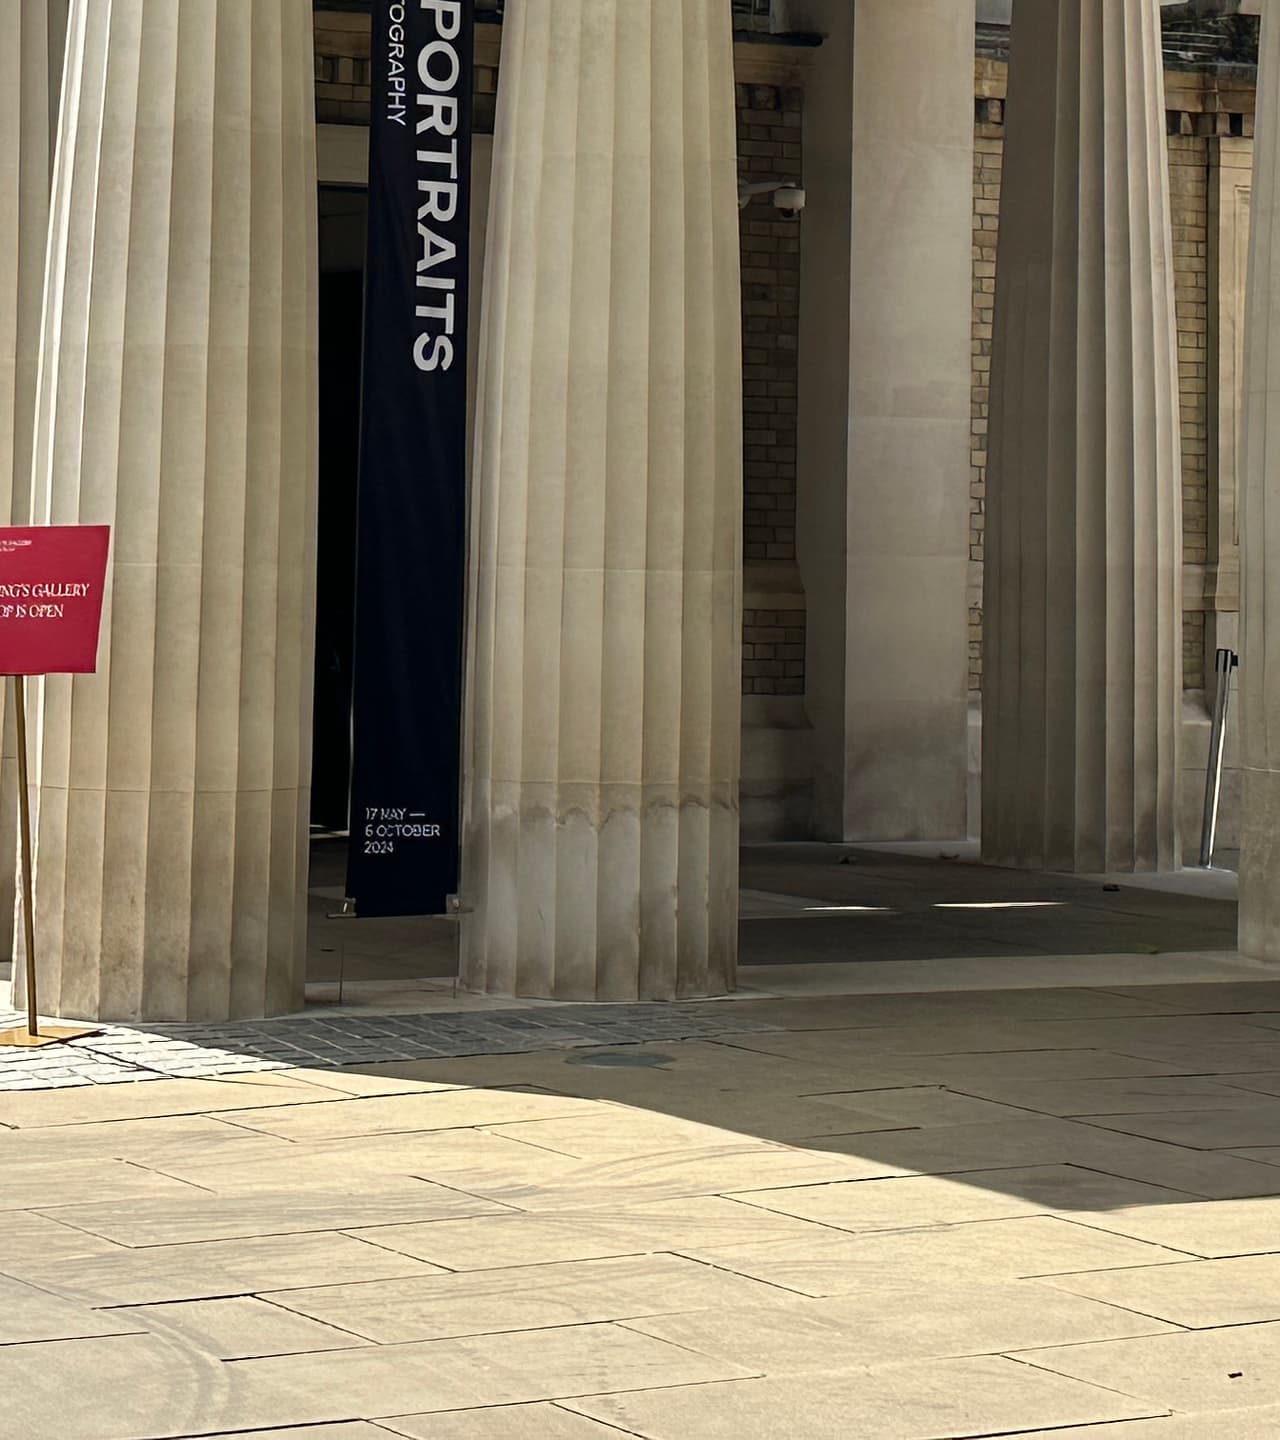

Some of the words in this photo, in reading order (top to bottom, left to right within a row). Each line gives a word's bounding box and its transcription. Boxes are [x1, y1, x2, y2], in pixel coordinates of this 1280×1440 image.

[32, 582, 91, 598] GALLERY
[15, 604, 27, 618] IS
[29, 603, 65, 618] OPEN
[365, 807, 378, 820] 17
[380, 807, 407, 820] MAY
[365, 824, 374, 837] 6
[376, 824, 440, 837] OCTOBER
